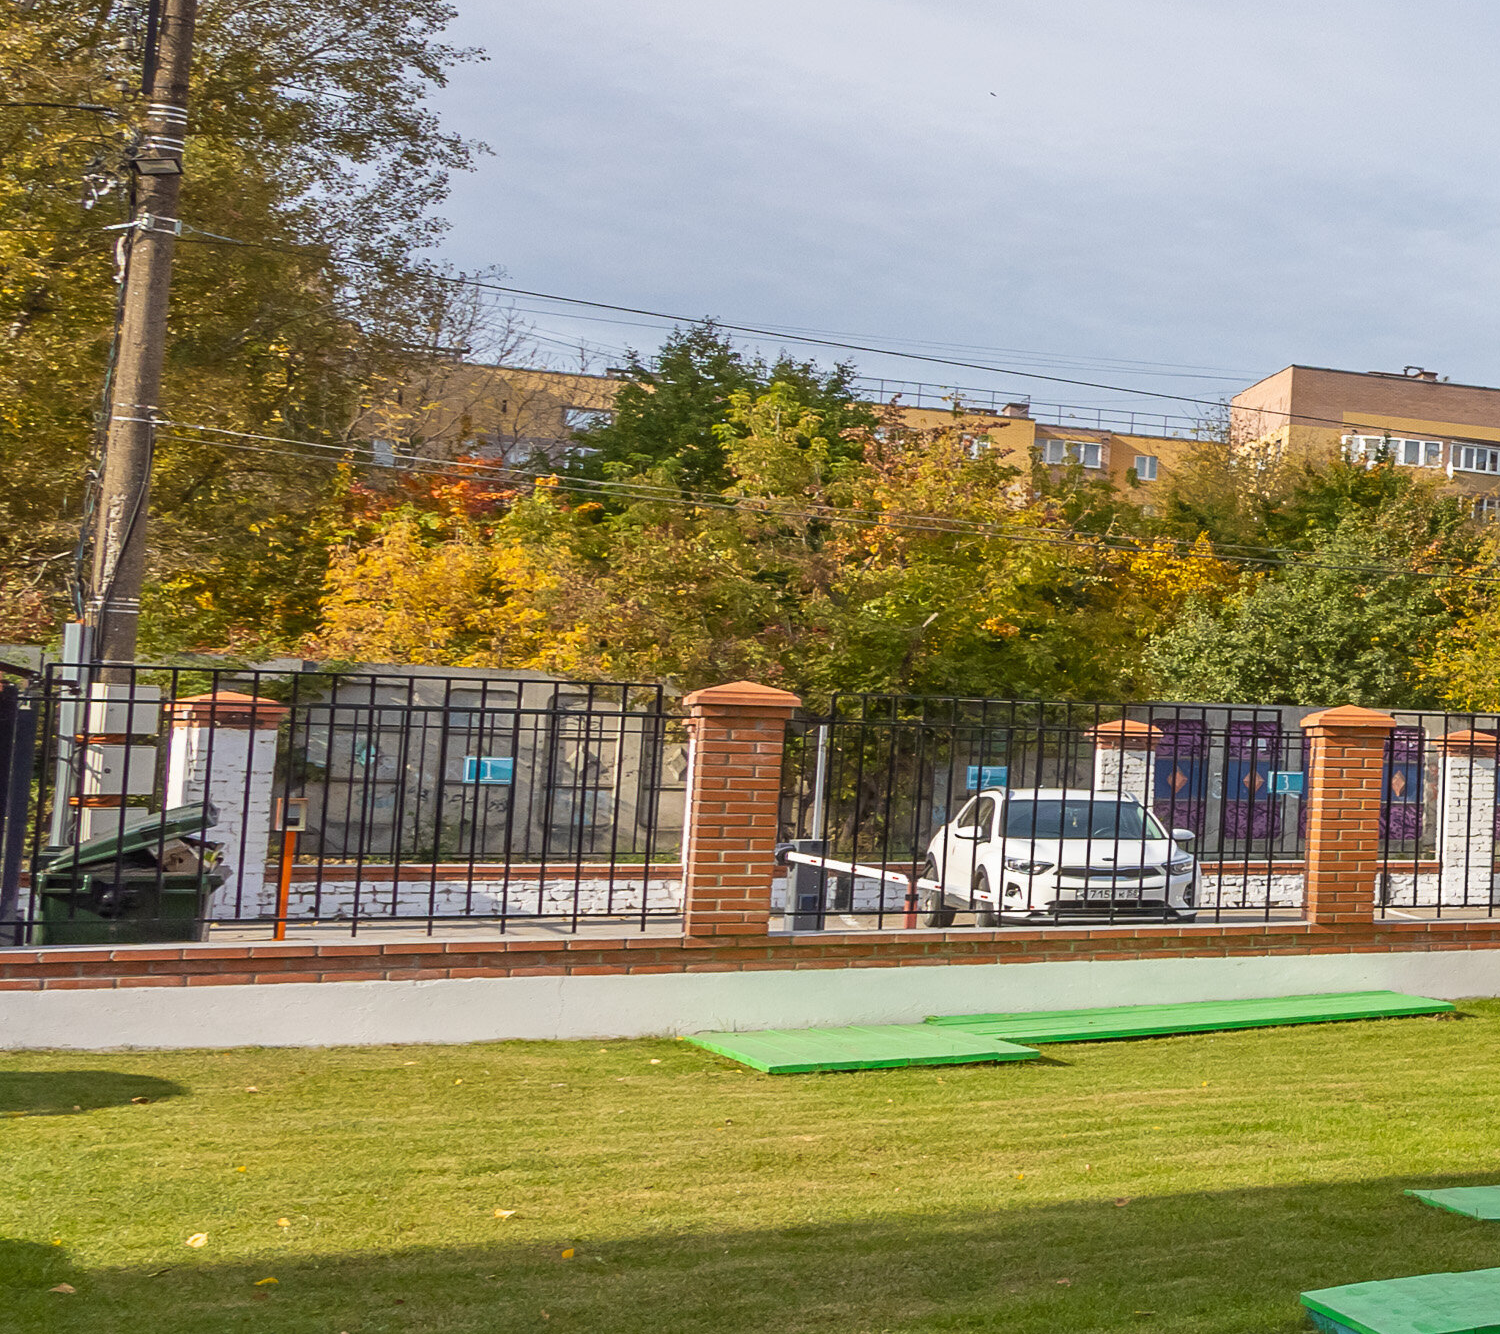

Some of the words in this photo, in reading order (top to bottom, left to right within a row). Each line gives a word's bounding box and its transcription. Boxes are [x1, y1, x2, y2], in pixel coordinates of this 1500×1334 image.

[484, 760, 493, 780] 1
[983, 769, 991, 786] 2
[1282, 775, 1290, 791] 3
